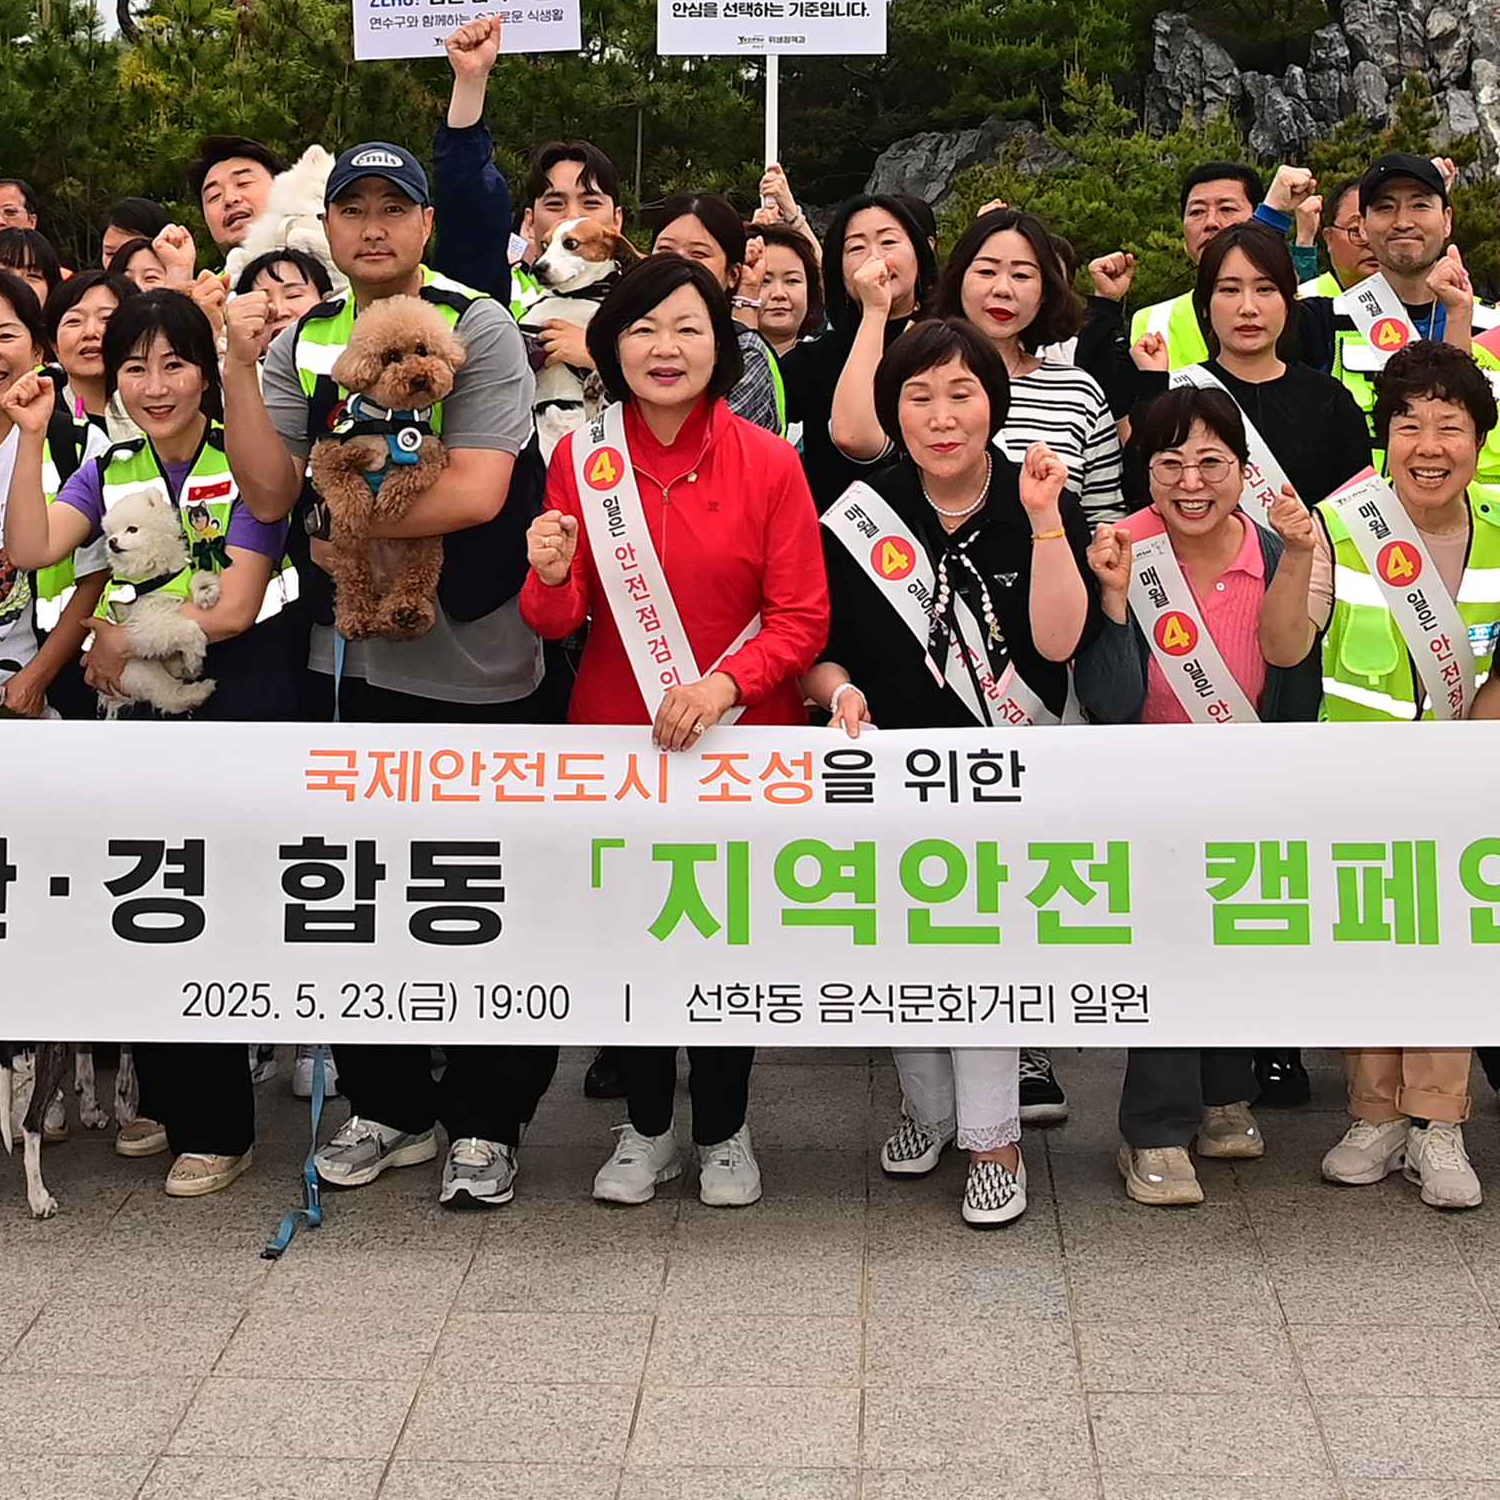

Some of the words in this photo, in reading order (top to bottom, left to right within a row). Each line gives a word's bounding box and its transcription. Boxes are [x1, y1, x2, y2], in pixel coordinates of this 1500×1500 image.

[369, 14, 419, 31] 연수구와
[422, 13, 471, 28] 함께하는
[527, 8, 564, 22] 식생활
[672, 2, 719, 18] 안심을
[722, 2, 785, 18] 선택하는
[788, 1, 871, 18] 기준입니다.
[1358, 289, 1384, 317] 매월
[844, 503, 880, 539] 매월
[1358, 500, 1392, 540] 매월
[1139, 565, 1170, 609] 매월
[303, 749, 669, 804] 국제안전도시
[698, 748, 877, 805] 조성을
[904, 748, 1026, 804] 위한
[279, 836, 506, 946] 합동
[181, 982, 281, 1023] 2025.
[294, 982, 327, 1023] 5.
[340, 981, 458, 1025] 23.(금)
[474, 984, 571, 1021] 19:00
[686, 982, 804, 1025] 선학동
[818, 982, 1056, 1025] 음식문화거리
[1070, 983, 1151, 1025] 일원
